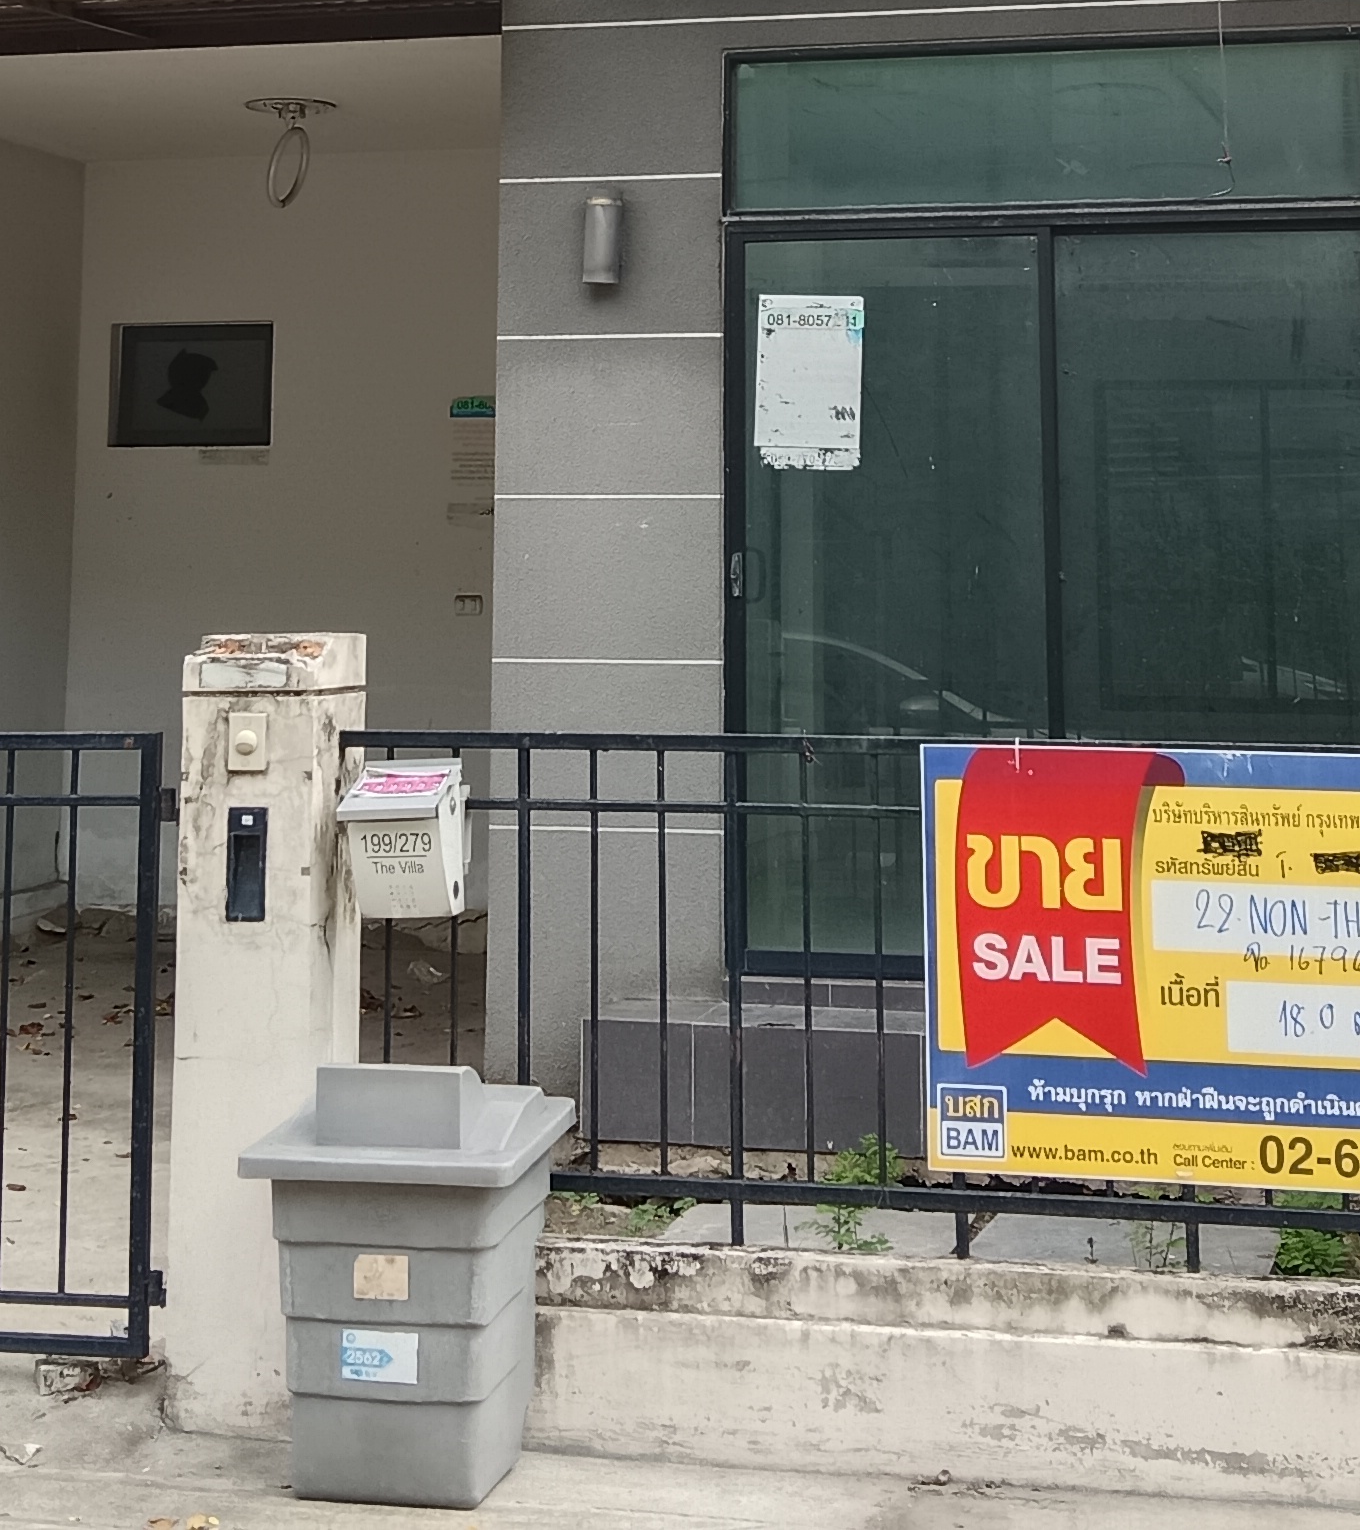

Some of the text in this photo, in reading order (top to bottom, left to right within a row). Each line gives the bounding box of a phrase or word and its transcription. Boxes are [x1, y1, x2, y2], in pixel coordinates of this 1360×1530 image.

[767, 313, 857, 327] 081-805711
[1152, 801, 1302, 828] บริษัทบริหารสินทรัพย์
[361, 832, 432, 854] 199/279
[371, 860, 425, 874] The Villa
[966, 833, 1123, 911] ขาย
[972, 932, 1122, 984] SALE
[1160, 973, 1220, 1008] เนื้อที่
[944, 1094, 999, 1119] บสก
[1028, 1078, 1127, 1112] ห้ามบุกรุก
[946, 1126, 1000, 1152] BAM
[1011, 1143, 1159, 1166] www.bam.co.th
[1173, 1153, 1198, 1168] Call
[345, 1349, 381, 1366] 2562
